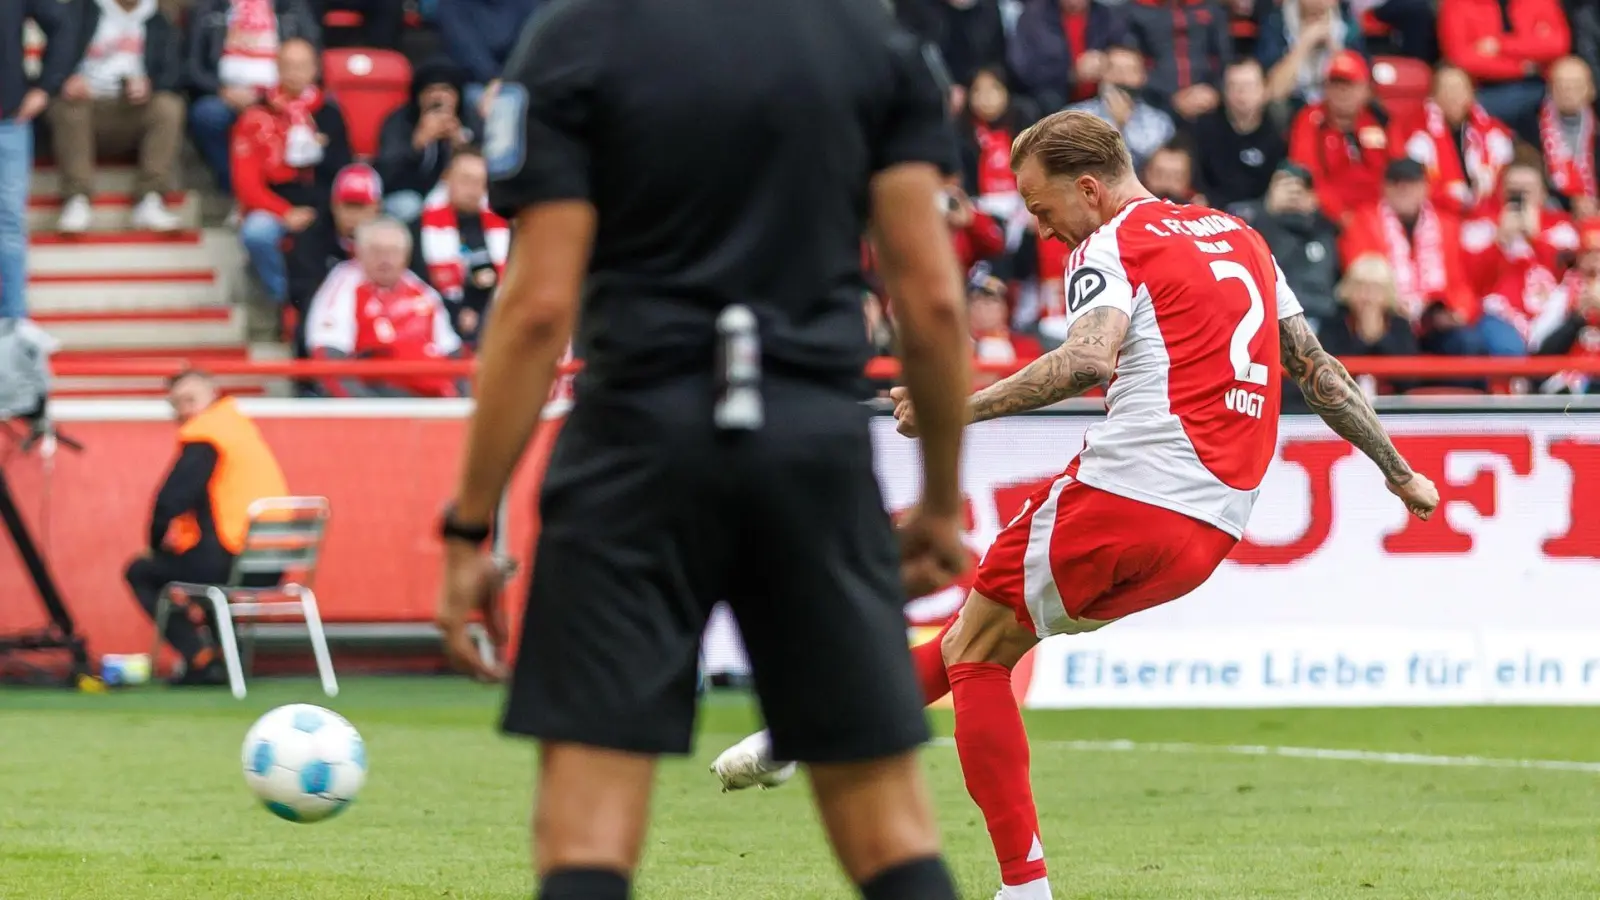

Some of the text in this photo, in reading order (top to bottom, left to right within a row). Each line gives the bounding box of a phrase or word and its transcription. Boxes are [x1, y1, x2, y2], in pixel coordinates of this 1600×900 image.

[1145, 223, 1171, 237] 1.
[1071, 272, 1102, 311] JD
[1209, 260, 1268, 386] 2
[1224, 387, 1266, 419] VOGT
[1065, 651, 1241, 687] Eiserne
[1263, 650, 1386, 687] Liebe
[1407, 651, 1470, 686] für
[1496, 648, 1563, 686] ein
